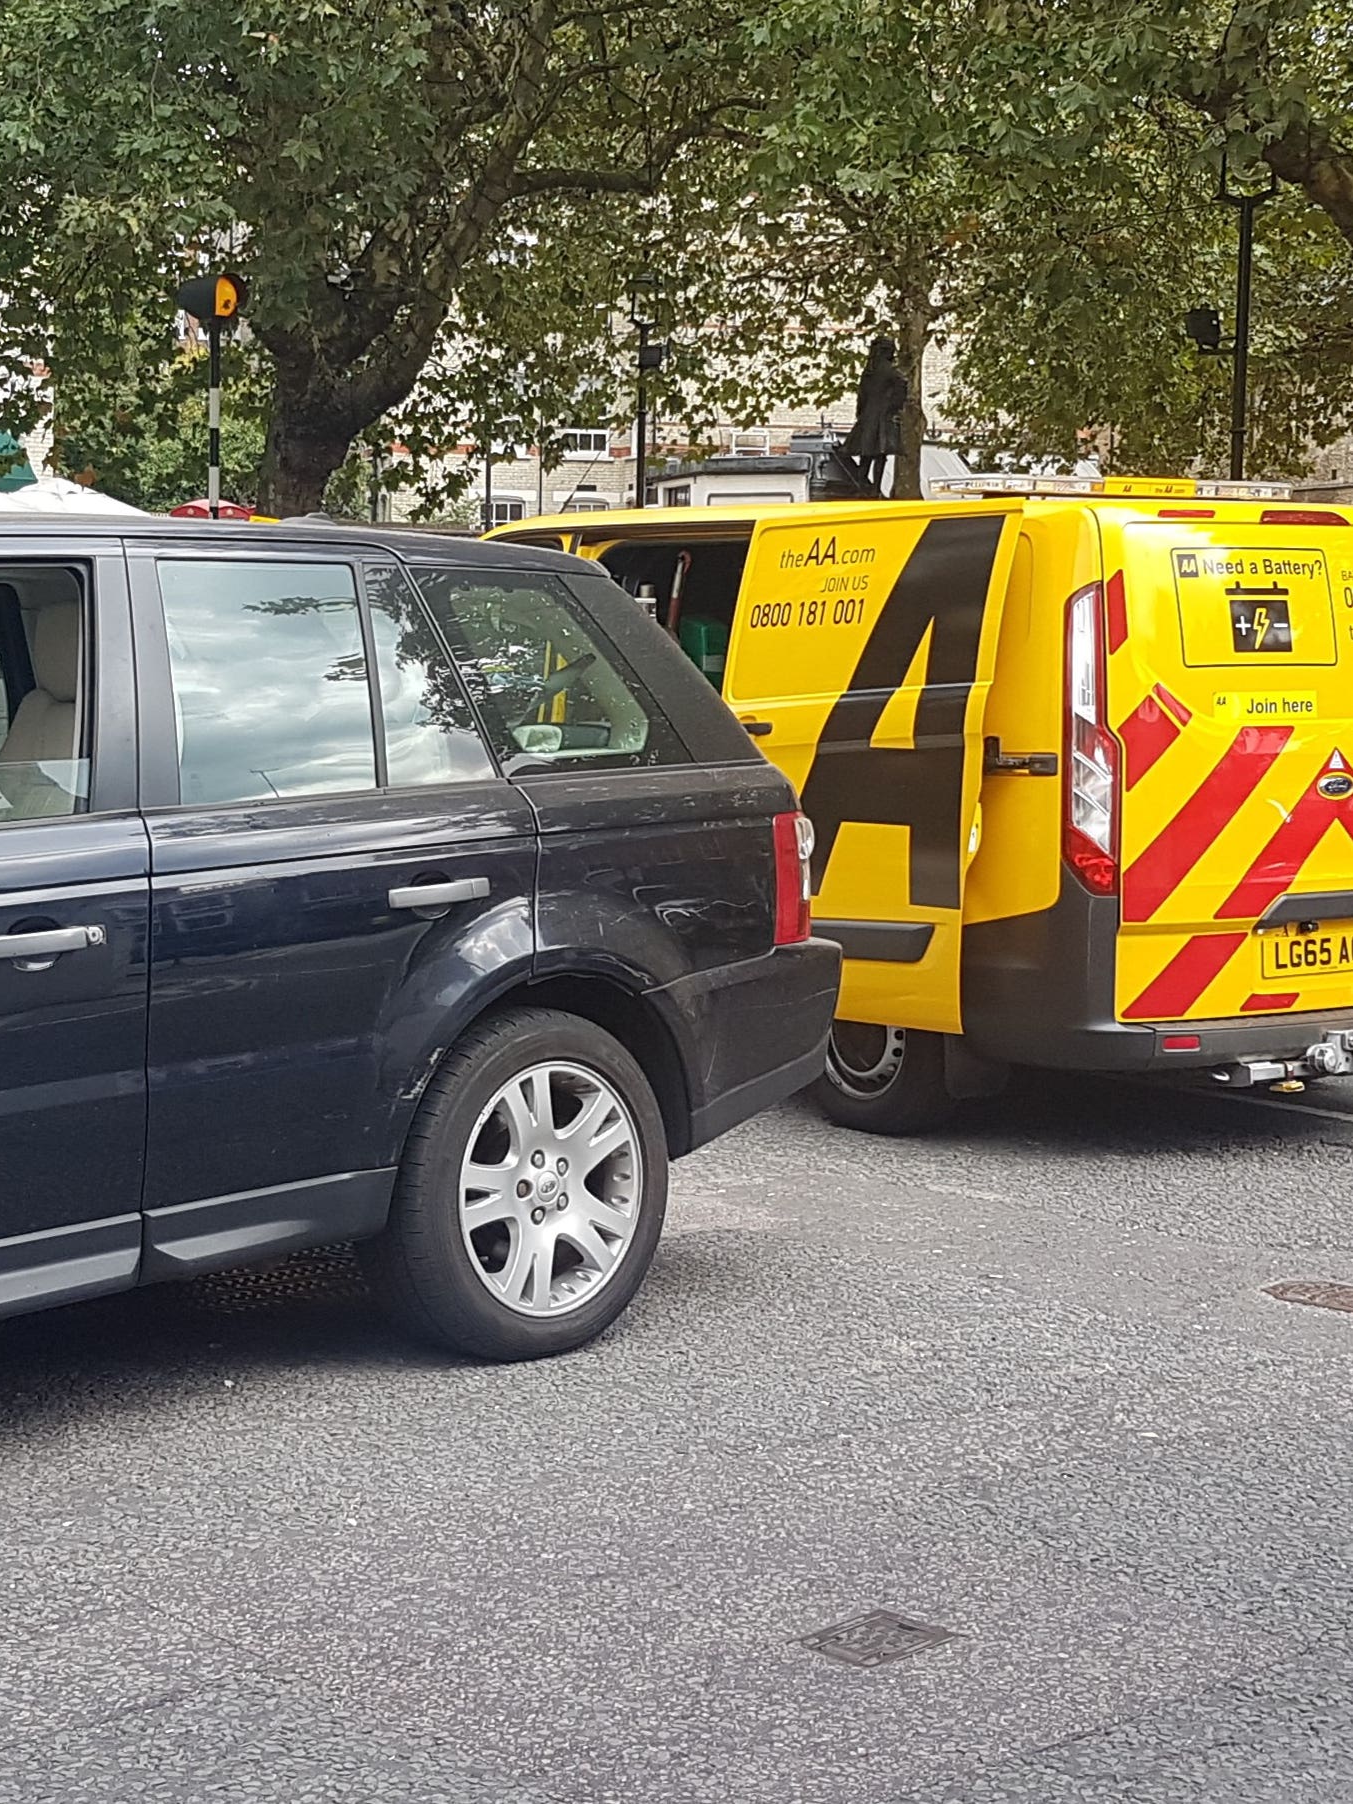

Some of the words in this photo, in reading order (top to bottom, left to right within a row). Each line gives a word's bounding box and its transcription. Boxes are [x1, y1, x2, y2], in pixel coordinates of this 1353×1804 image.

[779, 536, 876, 569] theAA.com
[1203, 559, 1244, 575] Need
[1249, 561, 1259, 574] a
[1263, 559, 1323, 580] Battery?
[820, 577, 849, 593] JOIN
[851, 575, 869, 591] US
[750, 602, 792, 629] 0800
[798, 600, 827, 626] 181
[833, 598, 865, 625] 001
[1246, 698, 1278, 714] Join
[1282, 697, 1314, 713] here
[1275, 937, 1332, 970] LG65
[1339, 936, 1353, 964] A
